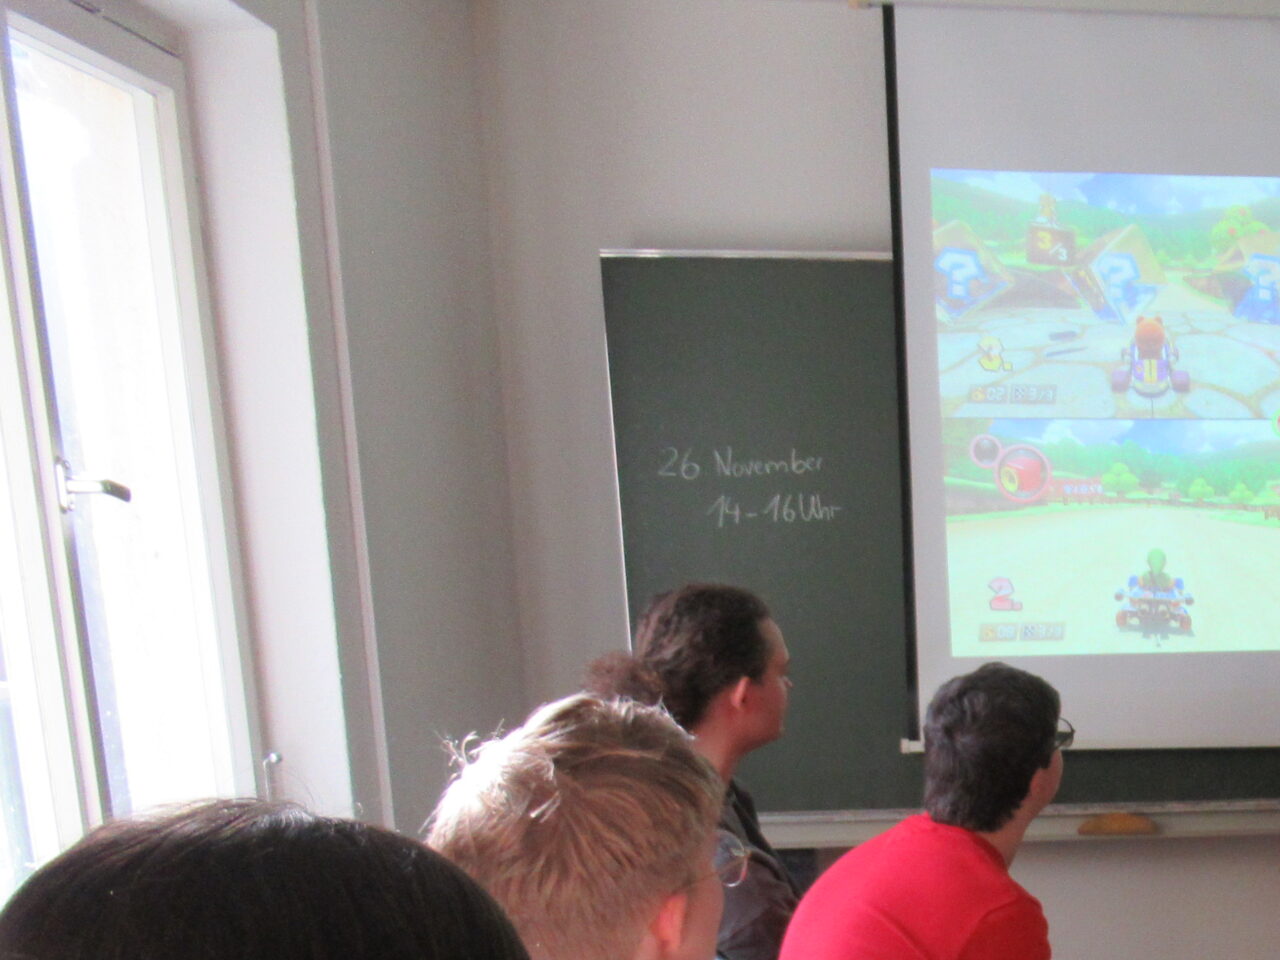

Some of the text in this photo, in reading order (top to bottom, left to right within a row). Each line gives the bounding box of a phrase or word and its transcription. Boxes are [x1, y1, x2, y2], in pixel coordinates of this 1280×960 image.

[658, 446, 824, 481] 26 November
[799, 494, 843, 522] Uhr
